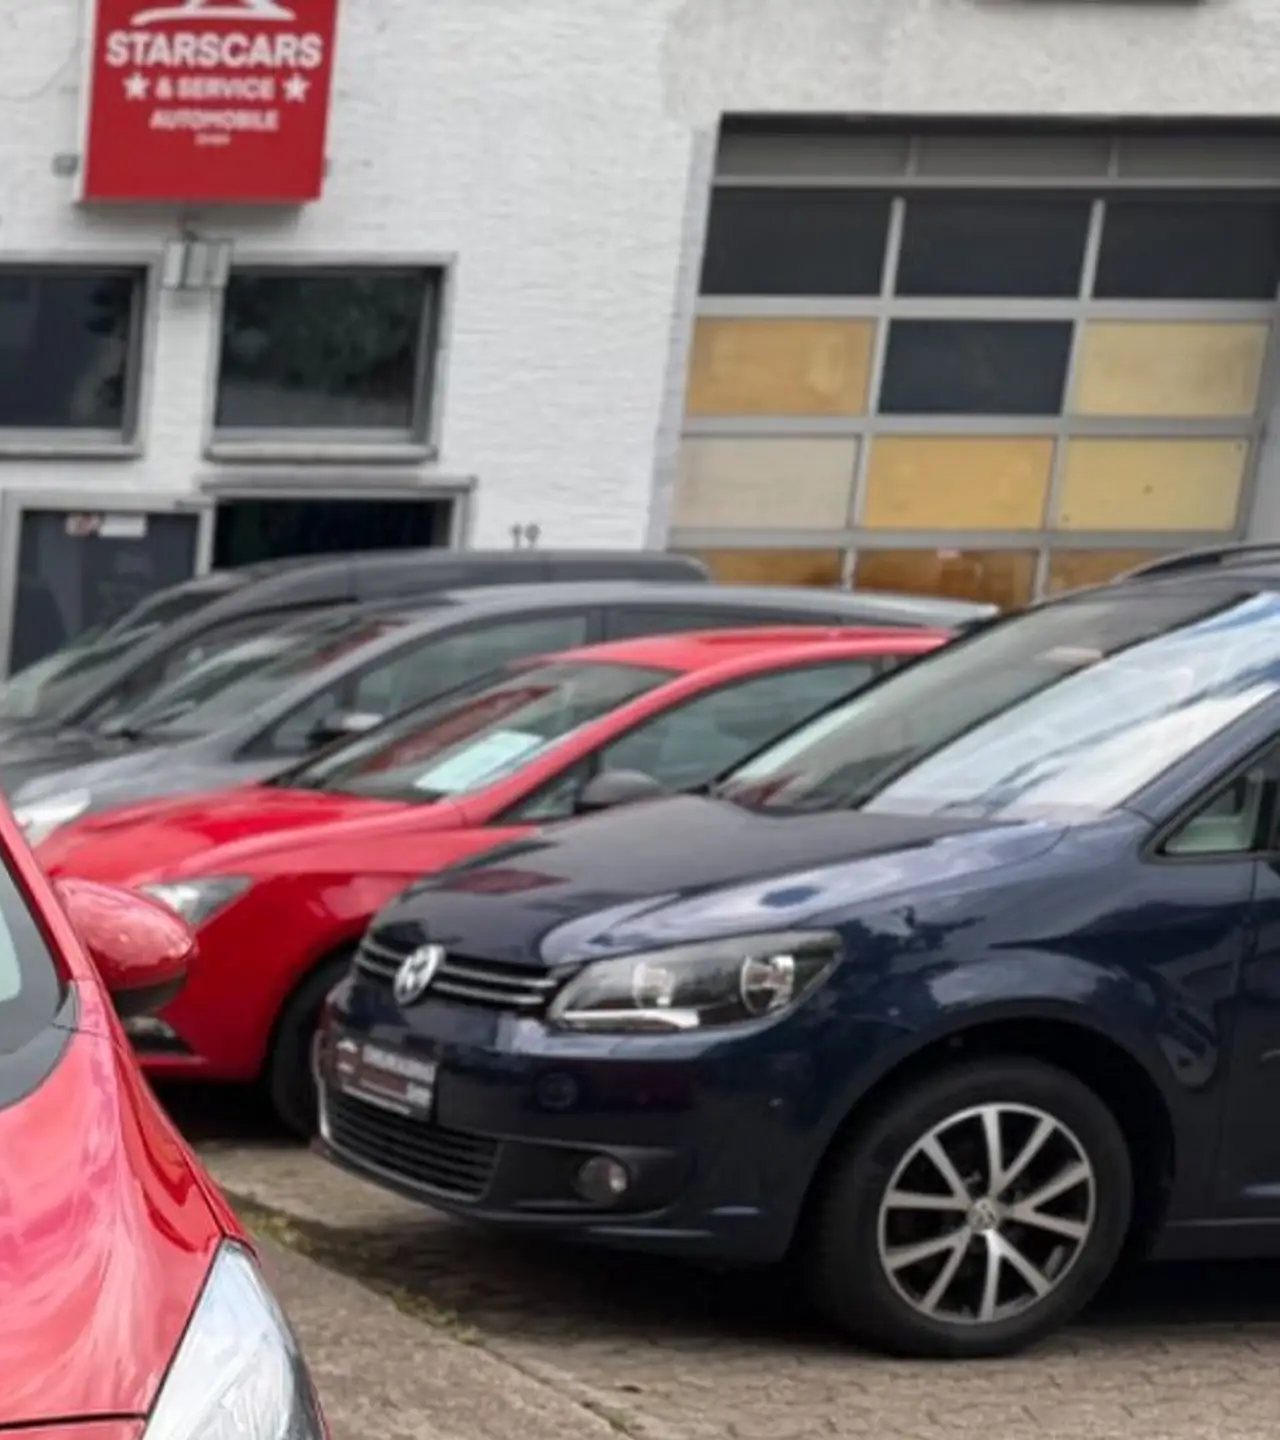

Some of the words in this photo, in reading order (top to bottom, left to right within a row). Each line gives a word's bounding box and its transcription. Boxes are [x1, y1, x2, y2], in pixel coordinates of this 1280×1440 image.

[105, 30, 323, 68] STARSCARS
[154, 77, 173, 99] &
[176, 76, 276, 101] SERVICE
[149, 109, 279, 131] AUTOMOBILE
